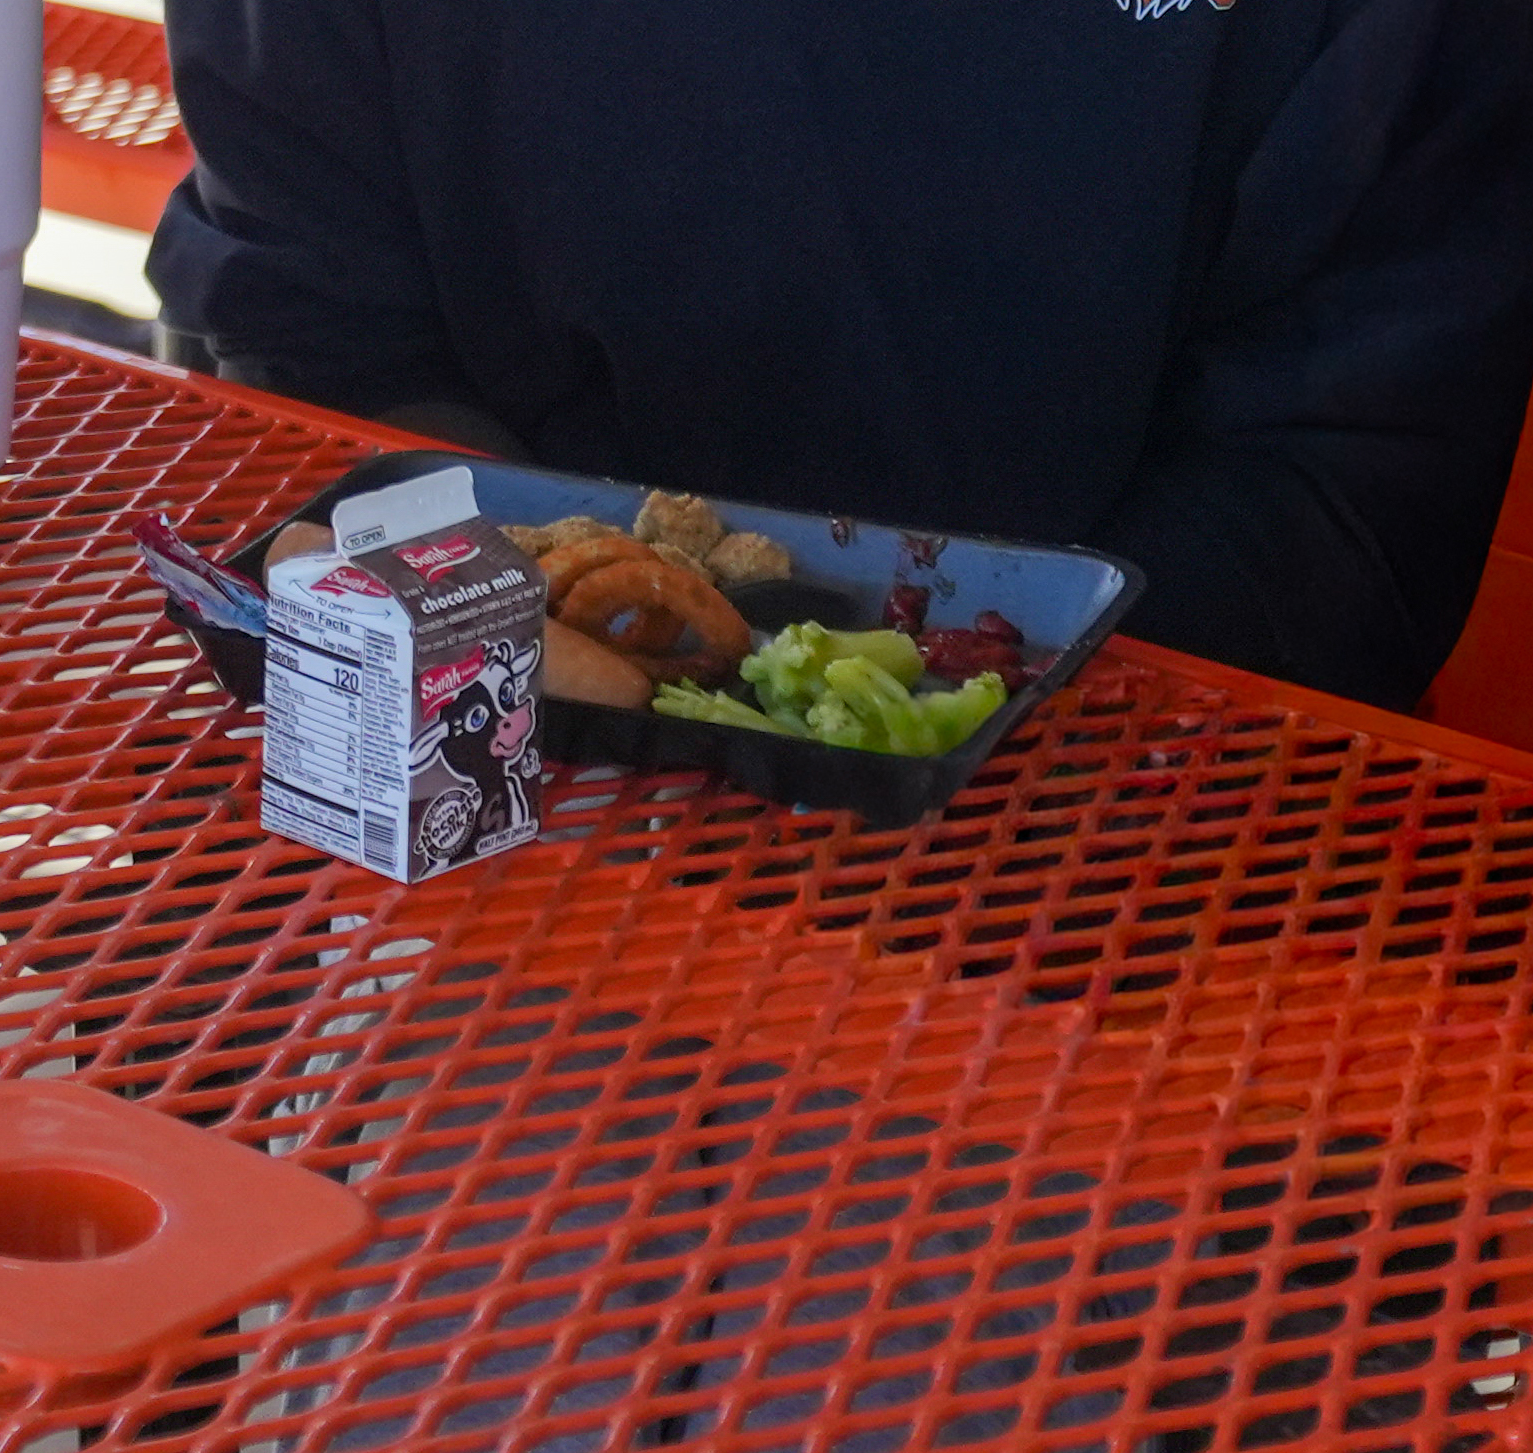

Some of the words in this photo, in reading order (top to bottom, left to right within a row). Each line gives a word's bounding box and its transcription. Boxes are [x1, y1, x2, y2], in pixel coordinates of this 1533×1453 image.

[349, 538, 360, 547] TO
[361, 531, 383, 544] OPEN
[403, 546, 452, 568] Sarah
[420, 582, 492, 615] chocolate
[491, 568, 527, 592] milk
[318, 612, 351, 634] Facts
[334, 667, 359, 691] 120
[421, 667, 462, 700] Sarah
[414, 790, 482, 854] chocolate
[438, 819, 465, 848] milk
